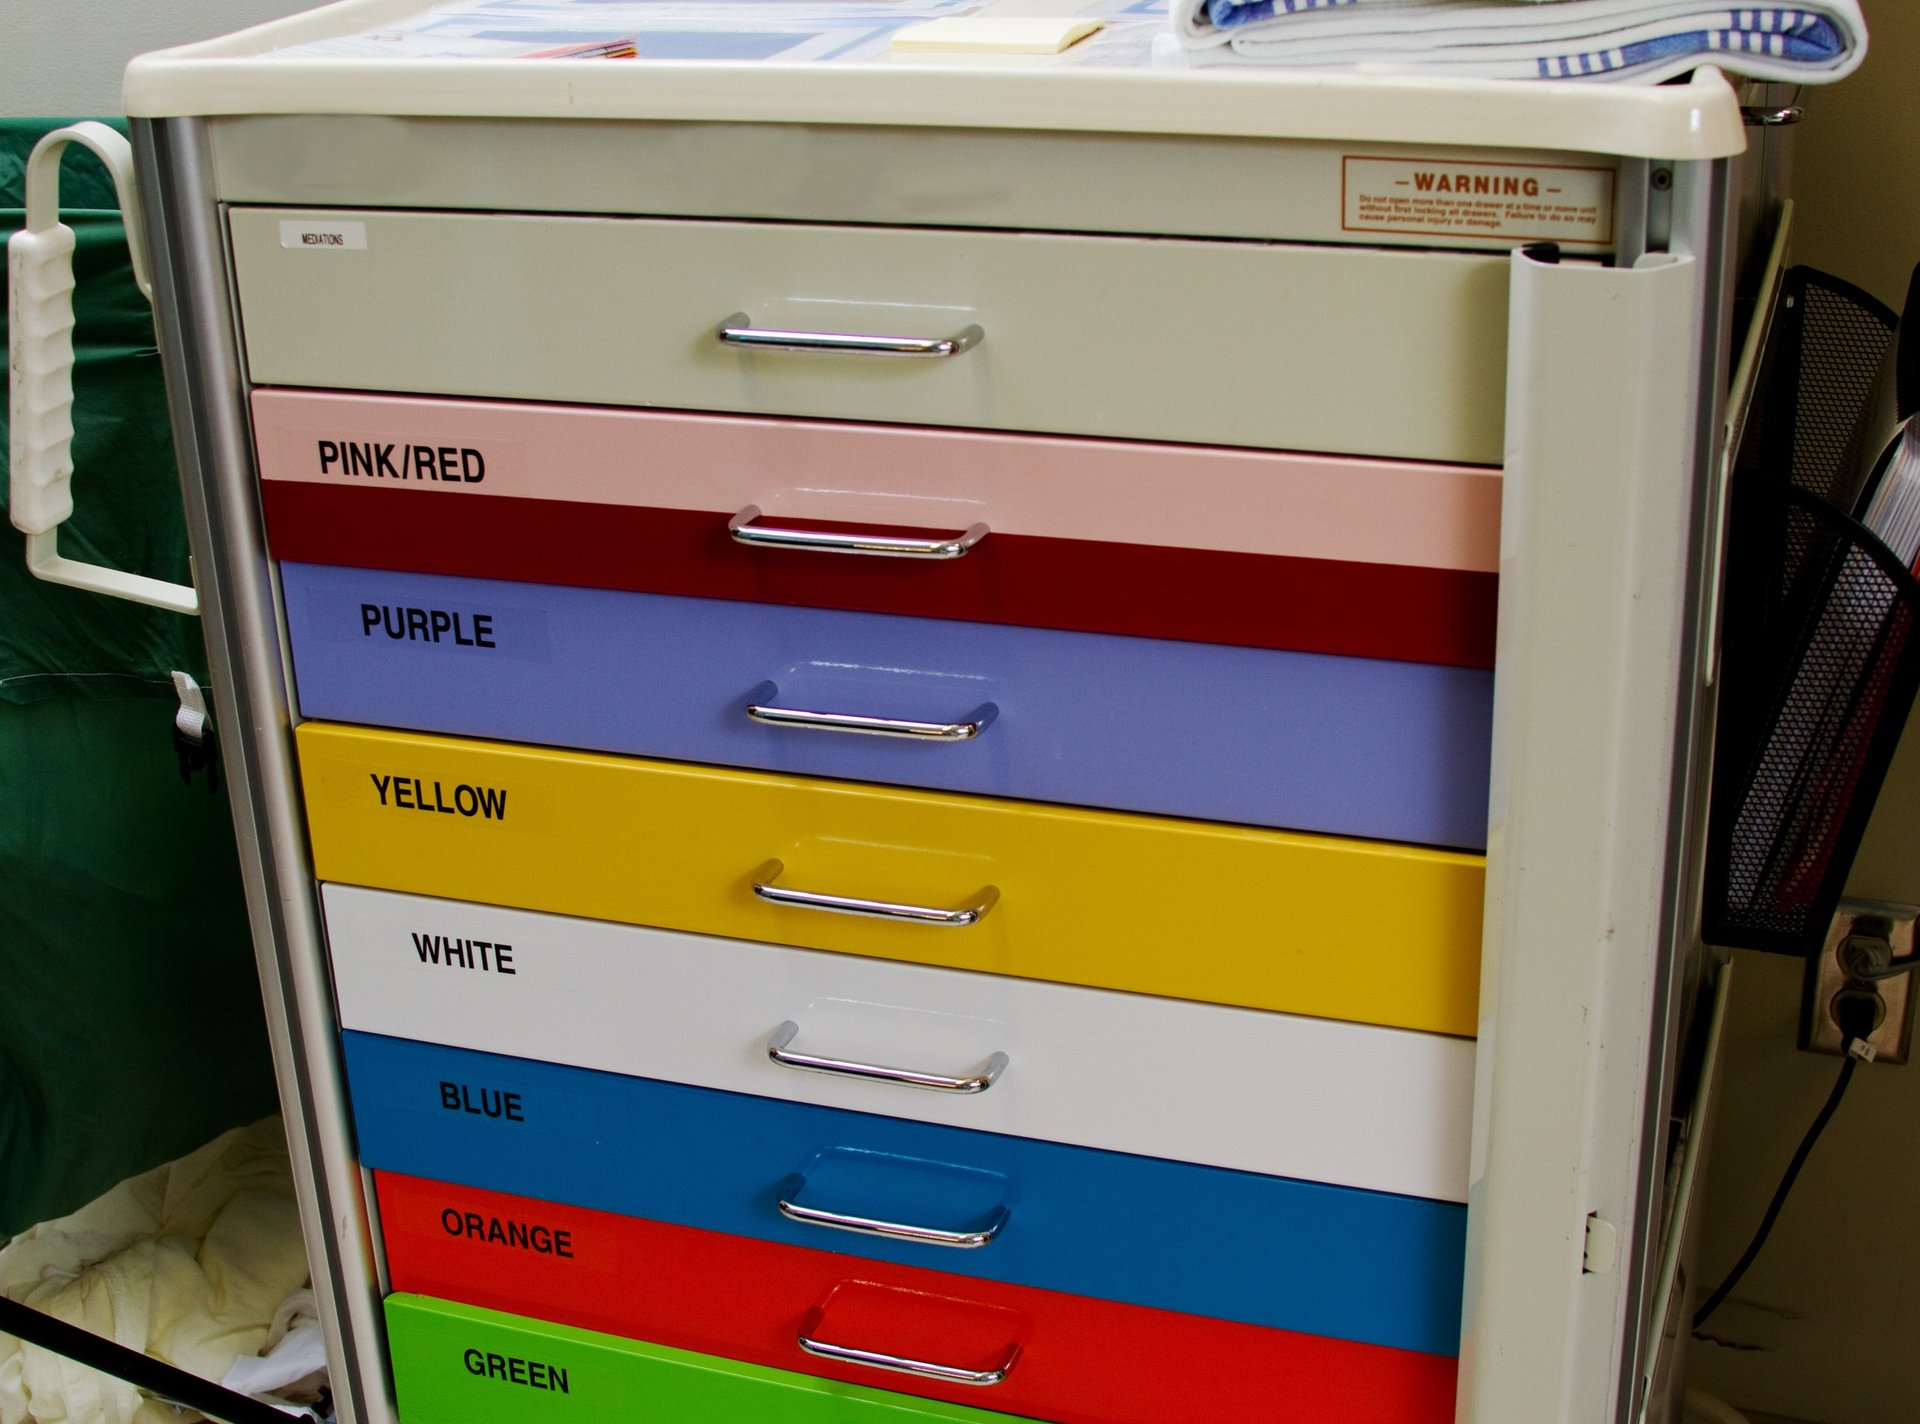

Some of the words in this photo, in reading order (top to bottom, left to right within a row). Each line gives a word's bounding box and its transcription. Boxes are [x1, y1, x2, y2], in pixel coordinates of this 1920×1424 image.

[1389, 197, 1410, 205] open
[1475, 200, 1503, 208] drawer
[1414, 172, 1538, 197] WARNING
[1387, 215, 1425, 223] personal
[1427, 216, 1451, 225] injury
[1395, 205, 1411, 213] first
[1414, 207, 1445, 216] locking
[1505, 211, 1535, 219] Failure
[1550, 213, 1561, 221] do
[1577, 216, 1596, 224] may
[302, 233, 344, 246] MEDIATIONS
[318, 440, 486, 483] PINK/RED
[361, 604, 495, 648] PURPLE
[371, 774, 506, 820] YELLOW
[412, 933, 516, 974] WHITE
[440, 1082, 523, 1121] BLUE
[441, 1208, 574, 1258] ORANGE
[464, 1349, 568, 1393] GREEN
